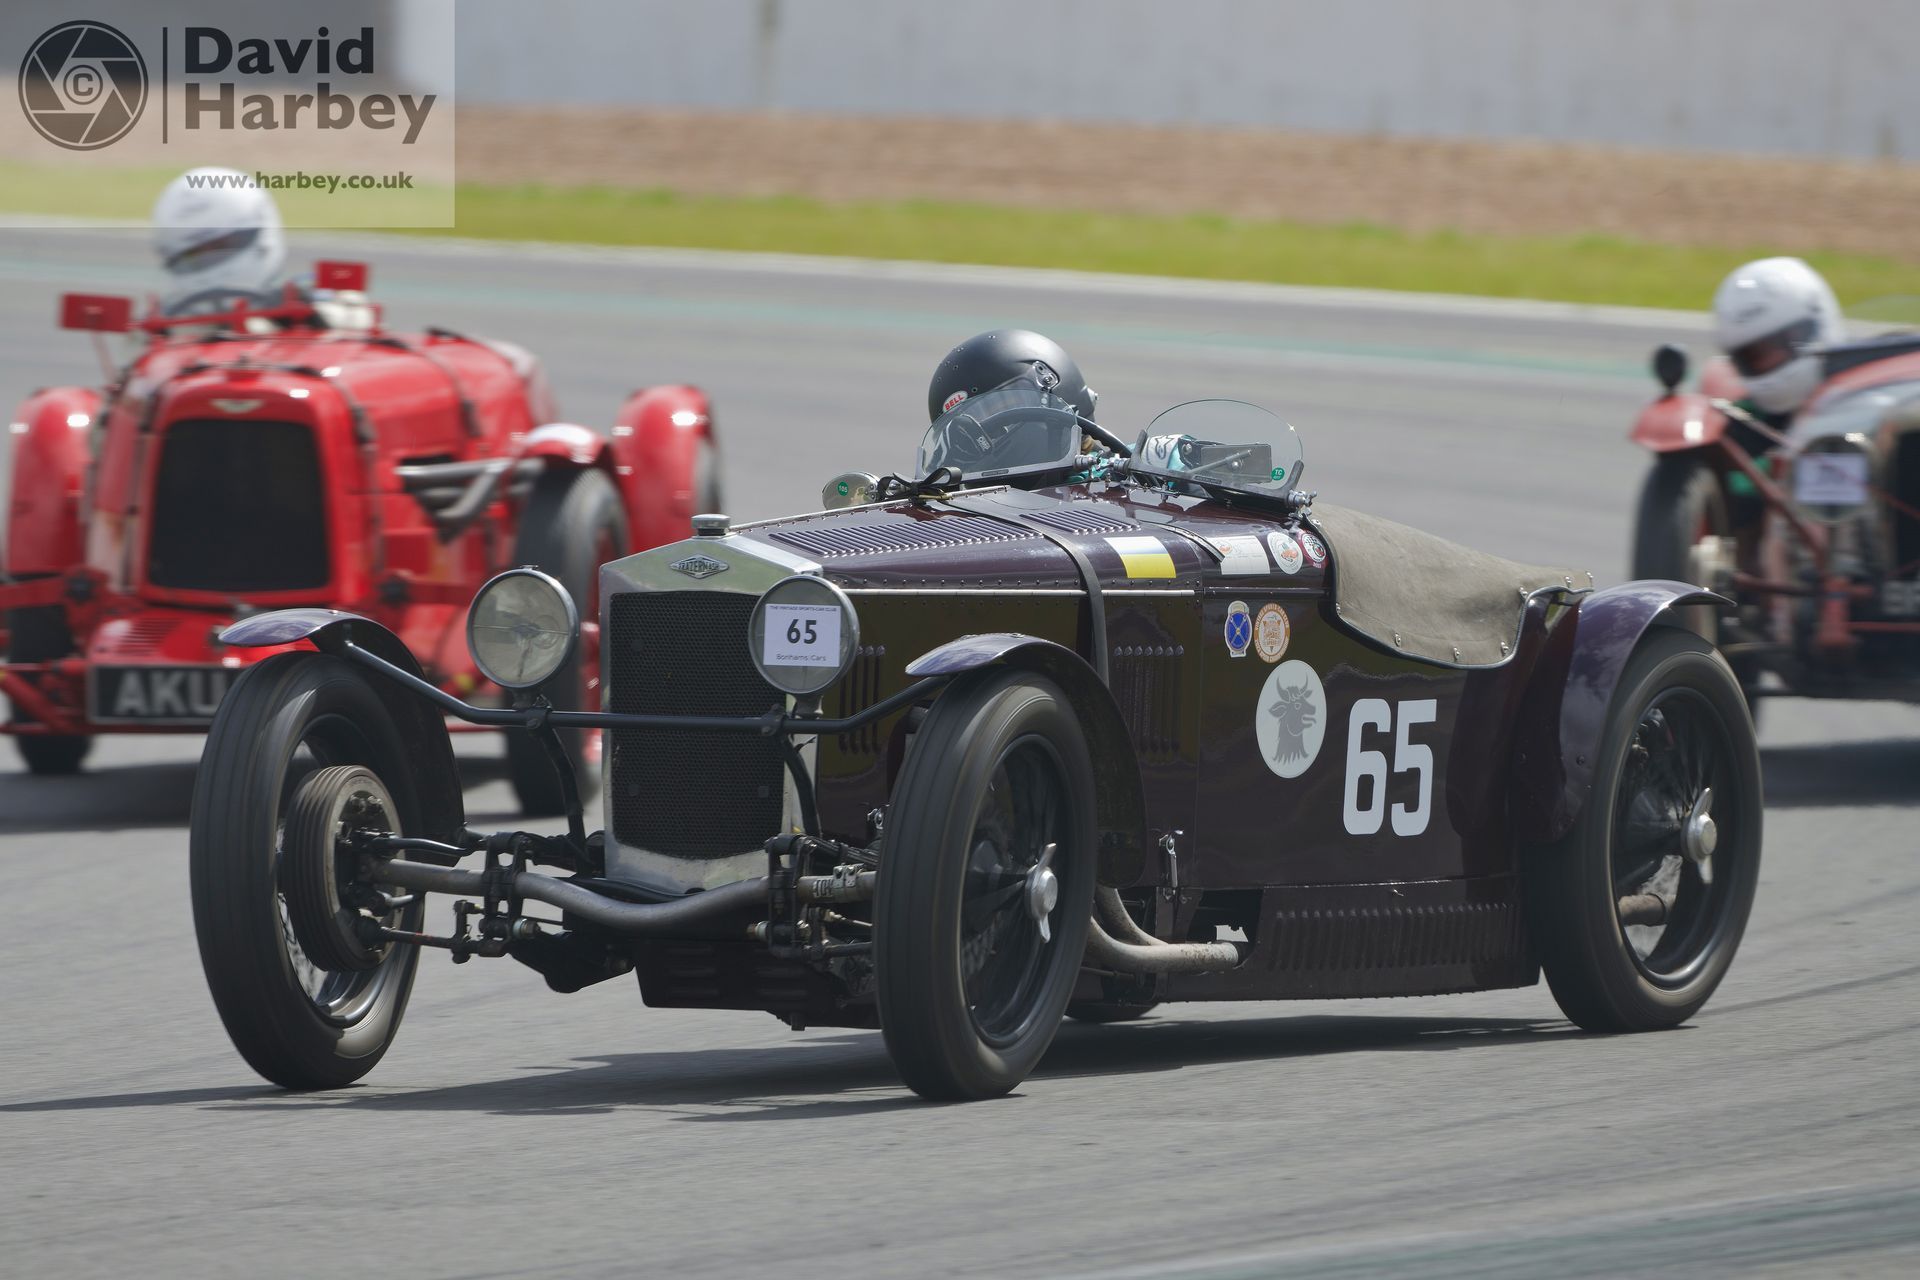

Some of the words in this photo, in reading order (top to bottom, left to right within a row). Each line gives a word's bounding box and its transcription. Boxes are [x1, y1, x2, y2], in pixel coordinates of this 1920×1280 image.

[944, 394, 965, 411] BELL
[787, 618, 818, 645] 65
[776, 653, 808, 662] Bonhams
[811, 654, 827, 662] Cars
[1343, 698, 1437, 837] 65
